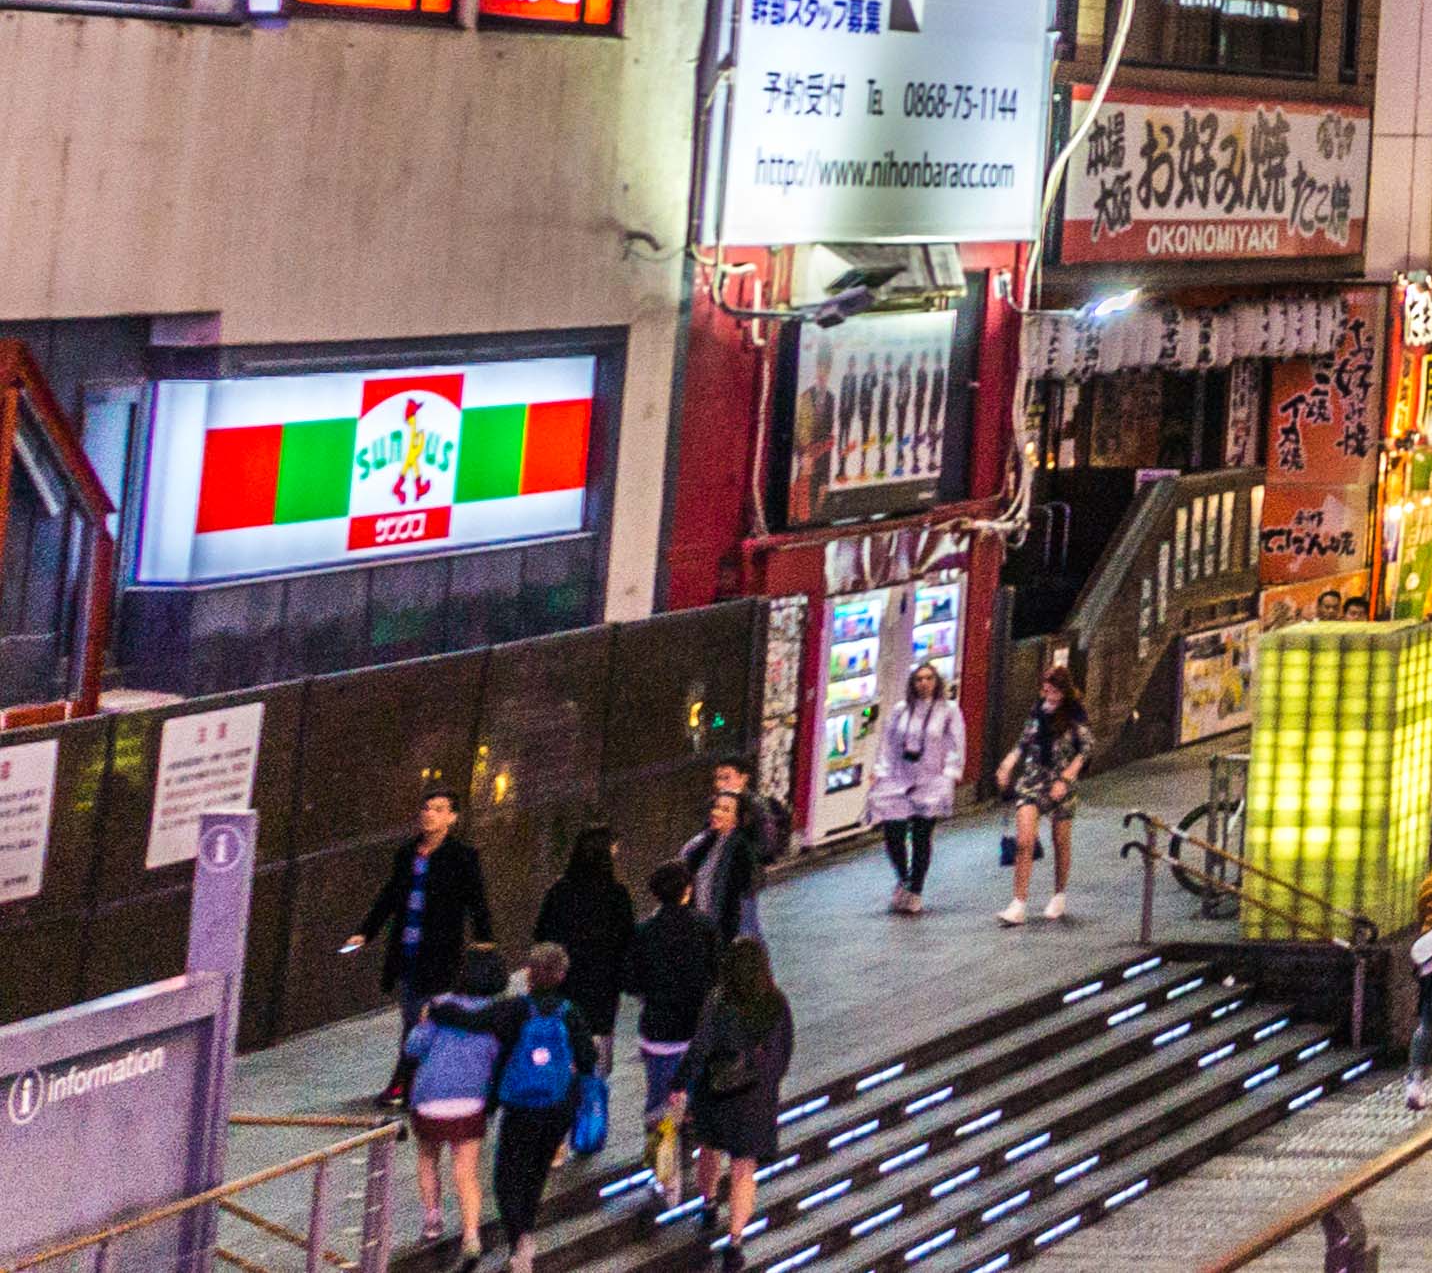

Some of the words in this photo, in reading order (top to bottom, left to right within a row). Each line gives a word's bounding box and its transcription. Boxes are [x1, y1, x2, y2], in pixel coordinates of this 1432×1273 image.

[902, 80, 1020, 123] 0868-75-1144
[1137, 105, 1293, 215] お好み焼
[1145, 218, 1279, 255] OKONOMIYAKI
[46, 1045, 166, 1106] information
